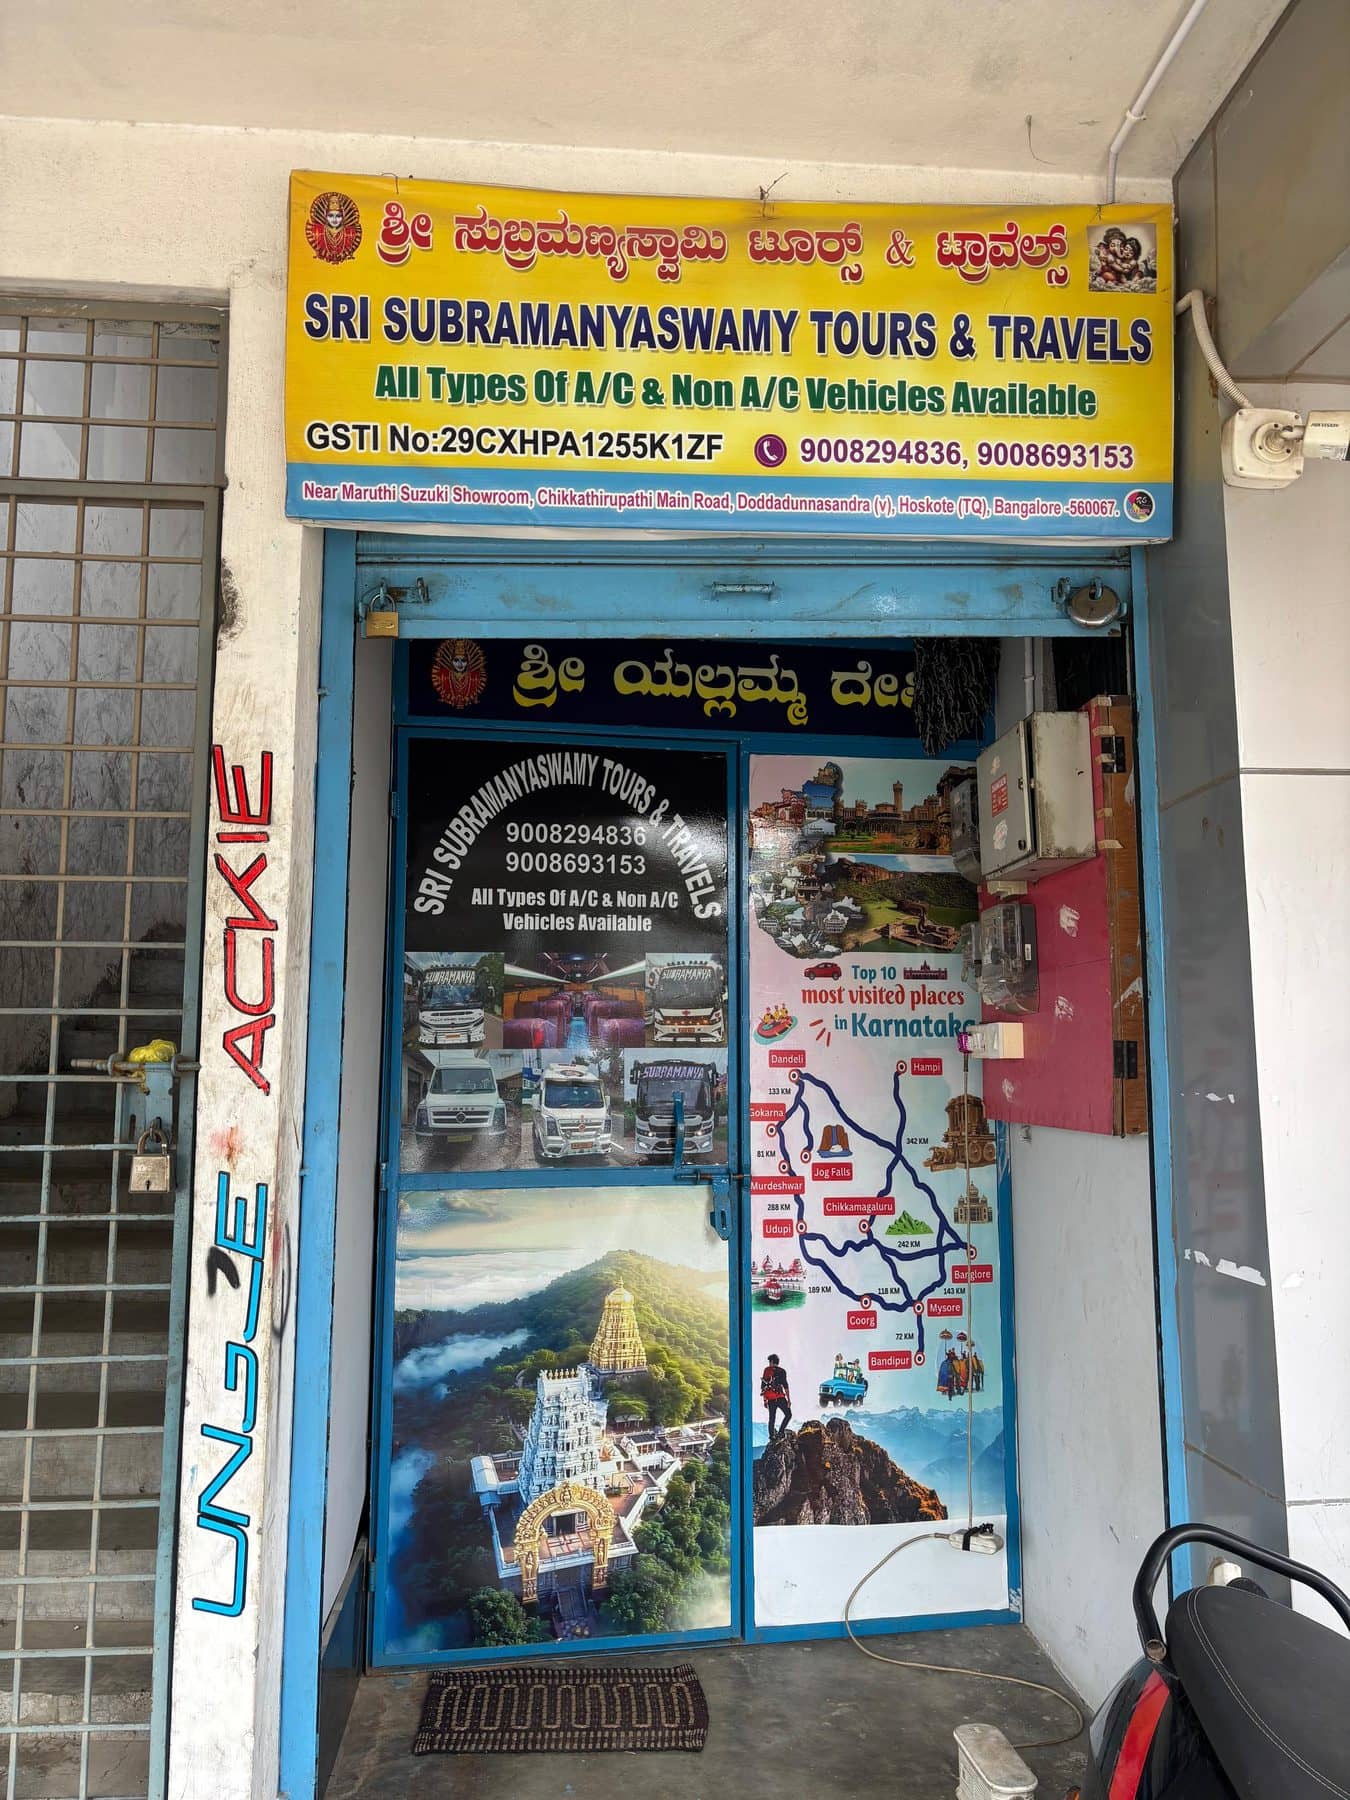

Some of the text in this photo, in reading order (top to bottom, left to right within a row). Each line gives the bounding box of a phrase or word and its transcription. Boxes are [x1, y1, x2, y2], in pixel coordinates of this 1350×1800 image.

[377, 202, 432, 264] ಶ್ರೀ
[454, 206, 727, 281] ಸುಬ್ರಮಣ್ಯಸ್ವಾಮಿ
[886, 229, 914, 266] &
[304, 294, 1152, 362] SRI SUBRAMANYASWAMY TOURS & TRAVELS
[376, 365, 1097, 417] All Types Of A/C & Non A/C Vehicles Available
[306, 423, 379, 452] GSTI
[800, 439, 1133, 470] 9008294836, 9008693153
[304, 482, 338, 500] Near
[341, 483, 397, 502] Maruthi
[400, 486, 449, 503] Suzuki
[453, 487, 535, 509] Showroom,
[537, 489, 654, 511] Chikkathirupathi
[656, 491, 690, 509] Main
[694, 492, 734, 513] Road,
[737, 494, 870, 513] Doddadunnasandra
[899, 498, 954, 514] Hoskote
[958, 498, 991, 518] (TQ),
[994, 498, 1062, 519] Bangalore
[1064, 501, 1120, 517] -560067.
[513, 644, 585, 708] ಶ್ರೀ
[614, 648, 808, 725] ಯಲ್ಲಮ್ಮ
[414, 752, 721, 919] SRI SUBRAMANYASWAMY TOURS & TRAVELS
[506, 823, 646, 845] 9008294836
[506, 852, 646, 874] 9008693153
[471, 888, 678, 908] All Types Of A/C & Non A/C
[503, 913, 652, 931] Vehicles Available
[852, 965, 897, 983] Top 10
[801, 984, 964, 1011] most visited places
[835, 1014, 847, 1030] in
[771, 1055, 804, 1063] Dandeli
[913, 1063, 941, 1072] Hampi
[814, 1167, 851, 1179] Jog Falls
[750, 1181, 802, 1191] Murdeshwar
[780, 1203, 791, 1211] KM
[825, 1201, 893, 1214] Chikkamagaluru
[765, 1224, 791, 1235] Udupi
[910, 1240, 921, 1248] KM
[889, 1287, 900, 1295] KM
[943, 1287, 966, 1295] 143 KM
[929, 1302, 961, 1315] Mysore
[849, 1315, 875, 1327] Coorg
[871, 1355, 910, 1368] Bandipur
